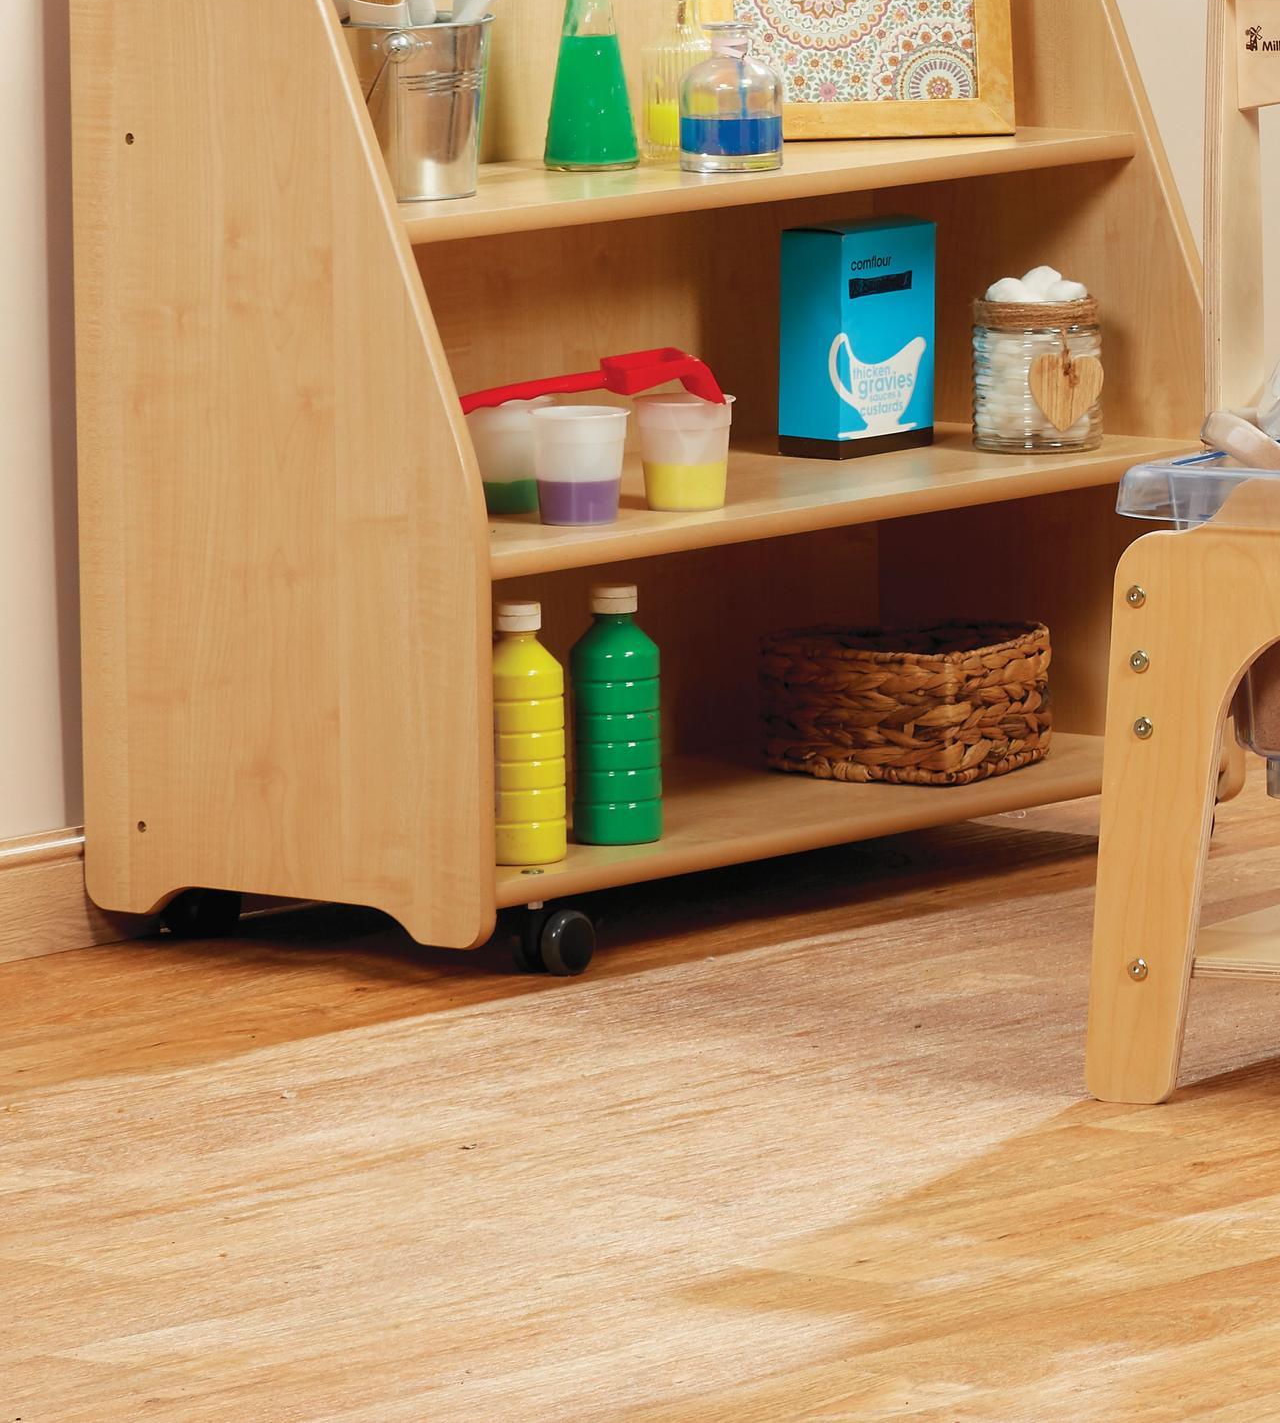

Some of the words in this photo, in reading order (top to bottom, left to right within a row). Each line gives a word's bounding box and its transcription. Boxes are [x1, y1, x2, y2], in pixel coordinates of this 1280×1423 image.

[853, 365, 891, 380] thicken
[858, 372, 913, 400] gravies
[860, 401, 904, 416] custards
